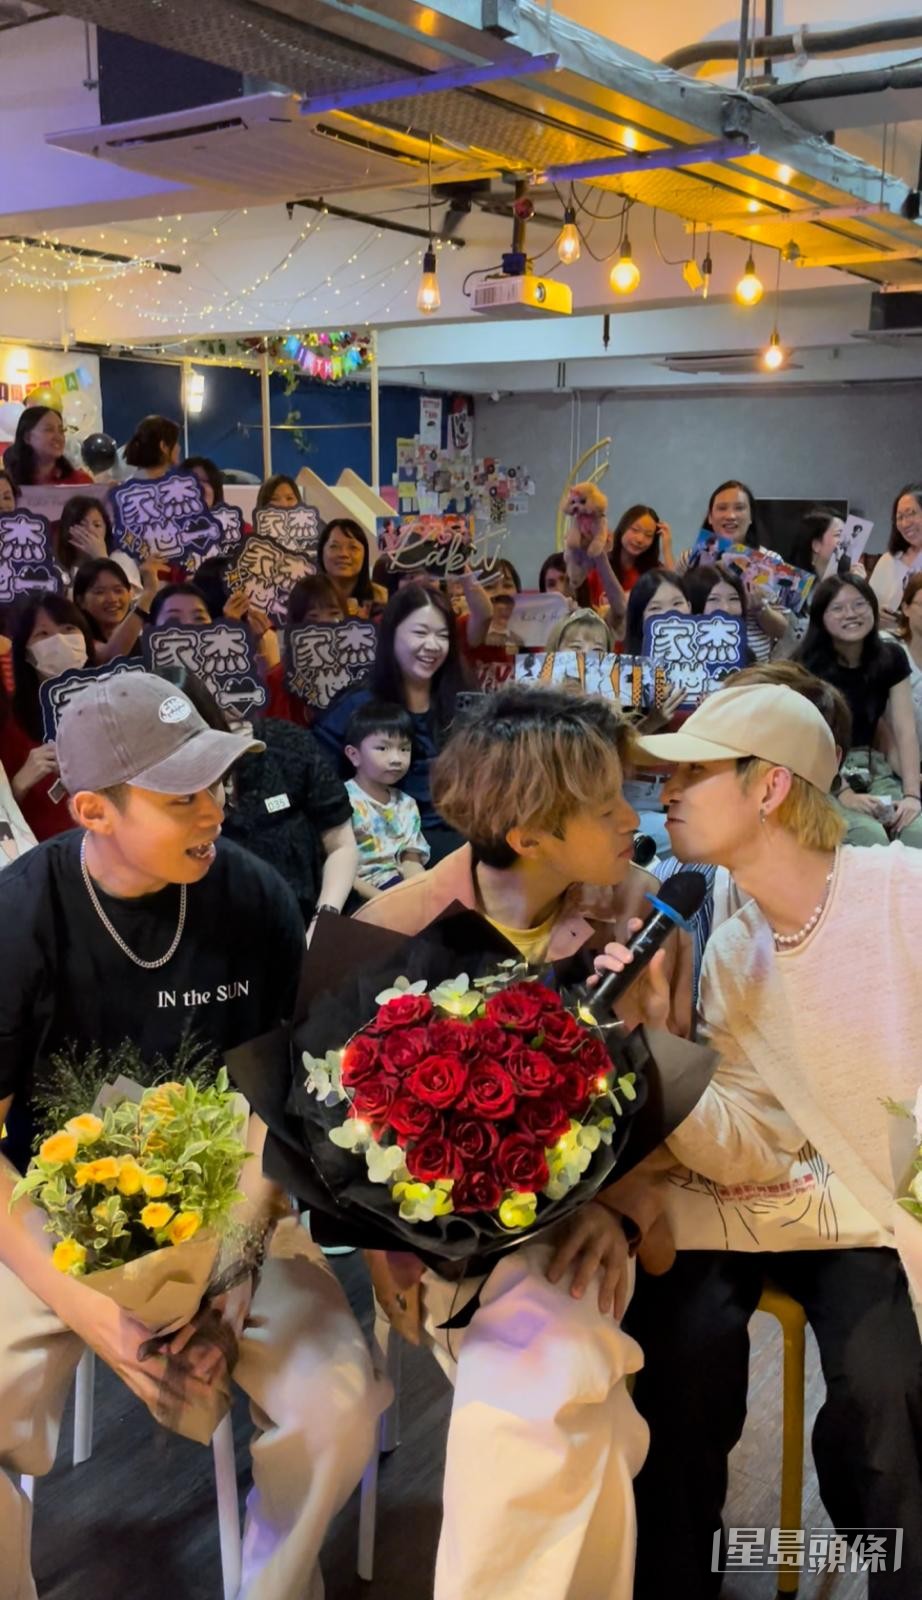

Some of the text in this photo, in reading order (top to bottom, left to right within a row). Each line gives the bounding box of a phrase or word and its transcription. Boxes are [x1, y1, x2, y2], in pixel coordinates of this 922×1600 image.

[651, 615, 740, 663] 家杰
[157, 980, 250, 1008] IN the SUN
